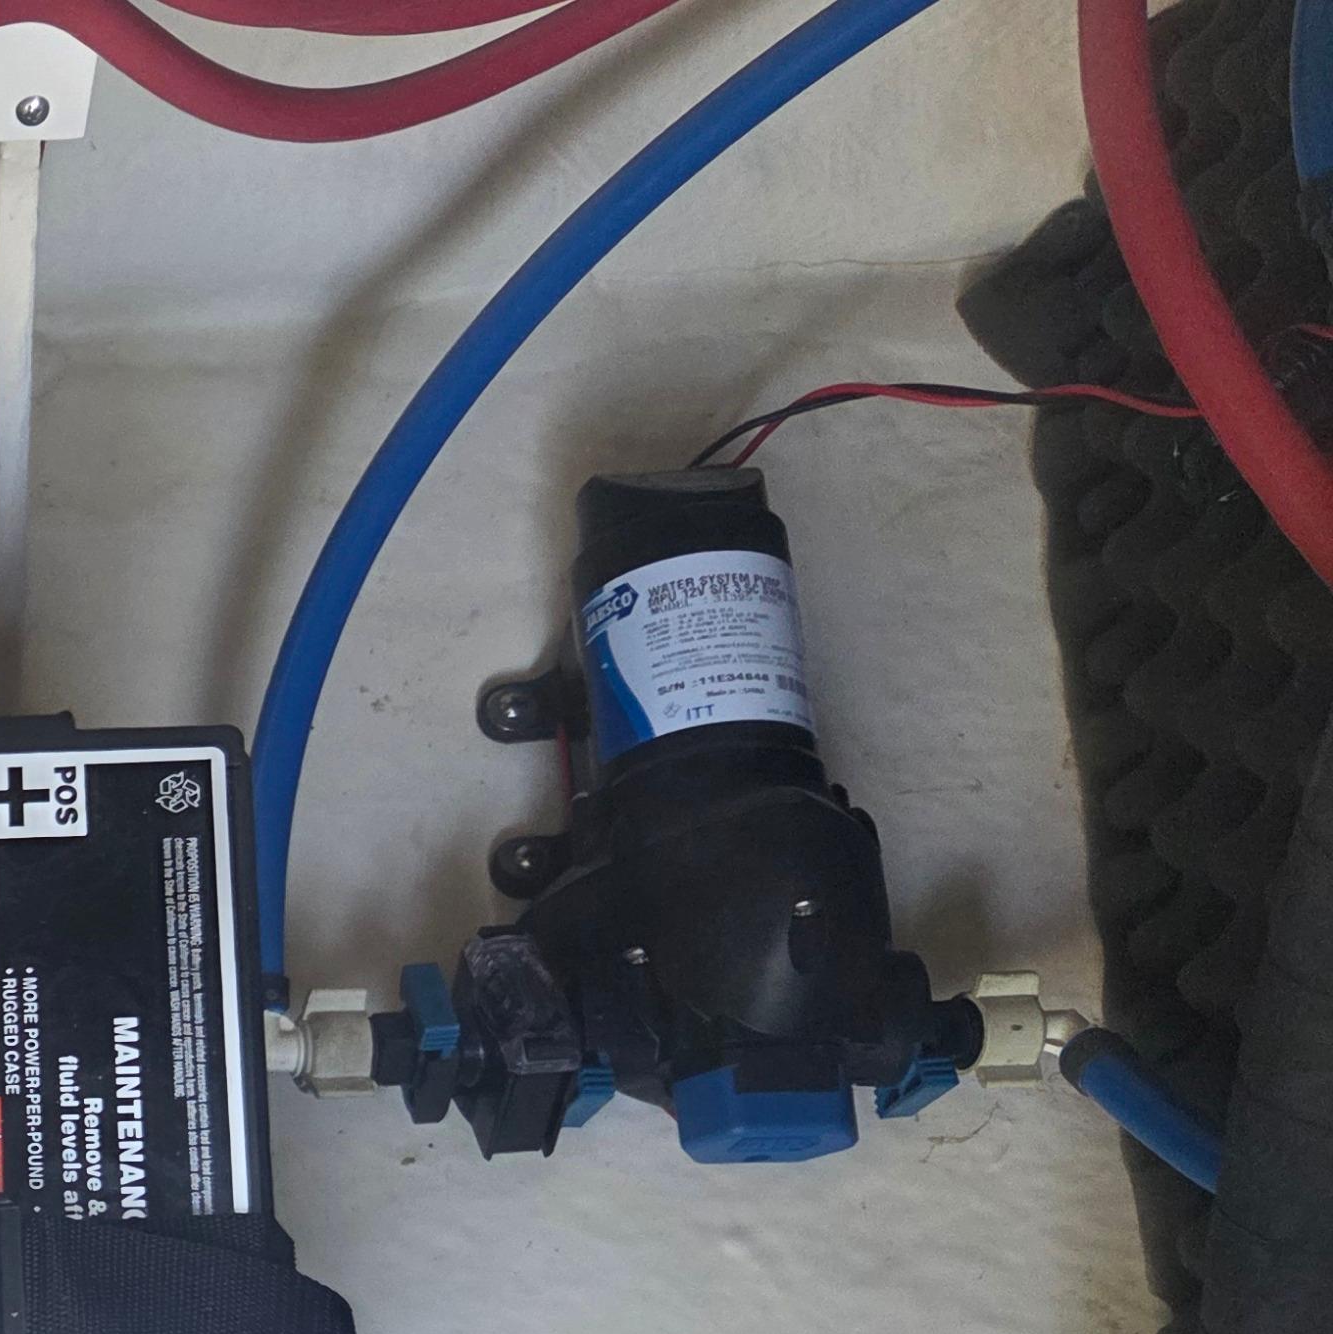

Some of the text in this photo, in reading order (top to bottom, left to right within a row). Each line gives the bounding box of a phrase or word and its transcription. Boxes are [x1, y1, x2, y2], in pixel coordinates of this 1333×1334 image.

[647, 578, 694, 597] WATER
[699, 572, 750, 587] SYSTEM
[685, 703, 715, 721] ITT
[52, 765, 79, 826] POS
[184, 836, 203, 946] PROPOSITION WARNING:
[1, 977, 20, 1095] RUGGED CASE
[21, 976, 44, 1190] MORE POWER-PER-POUND
[57, 1054, 82, 1183] fluid levels
[82, 1096, 103, 1192] Remove
[112, 1016, 146, 1220] MAINTENAN
